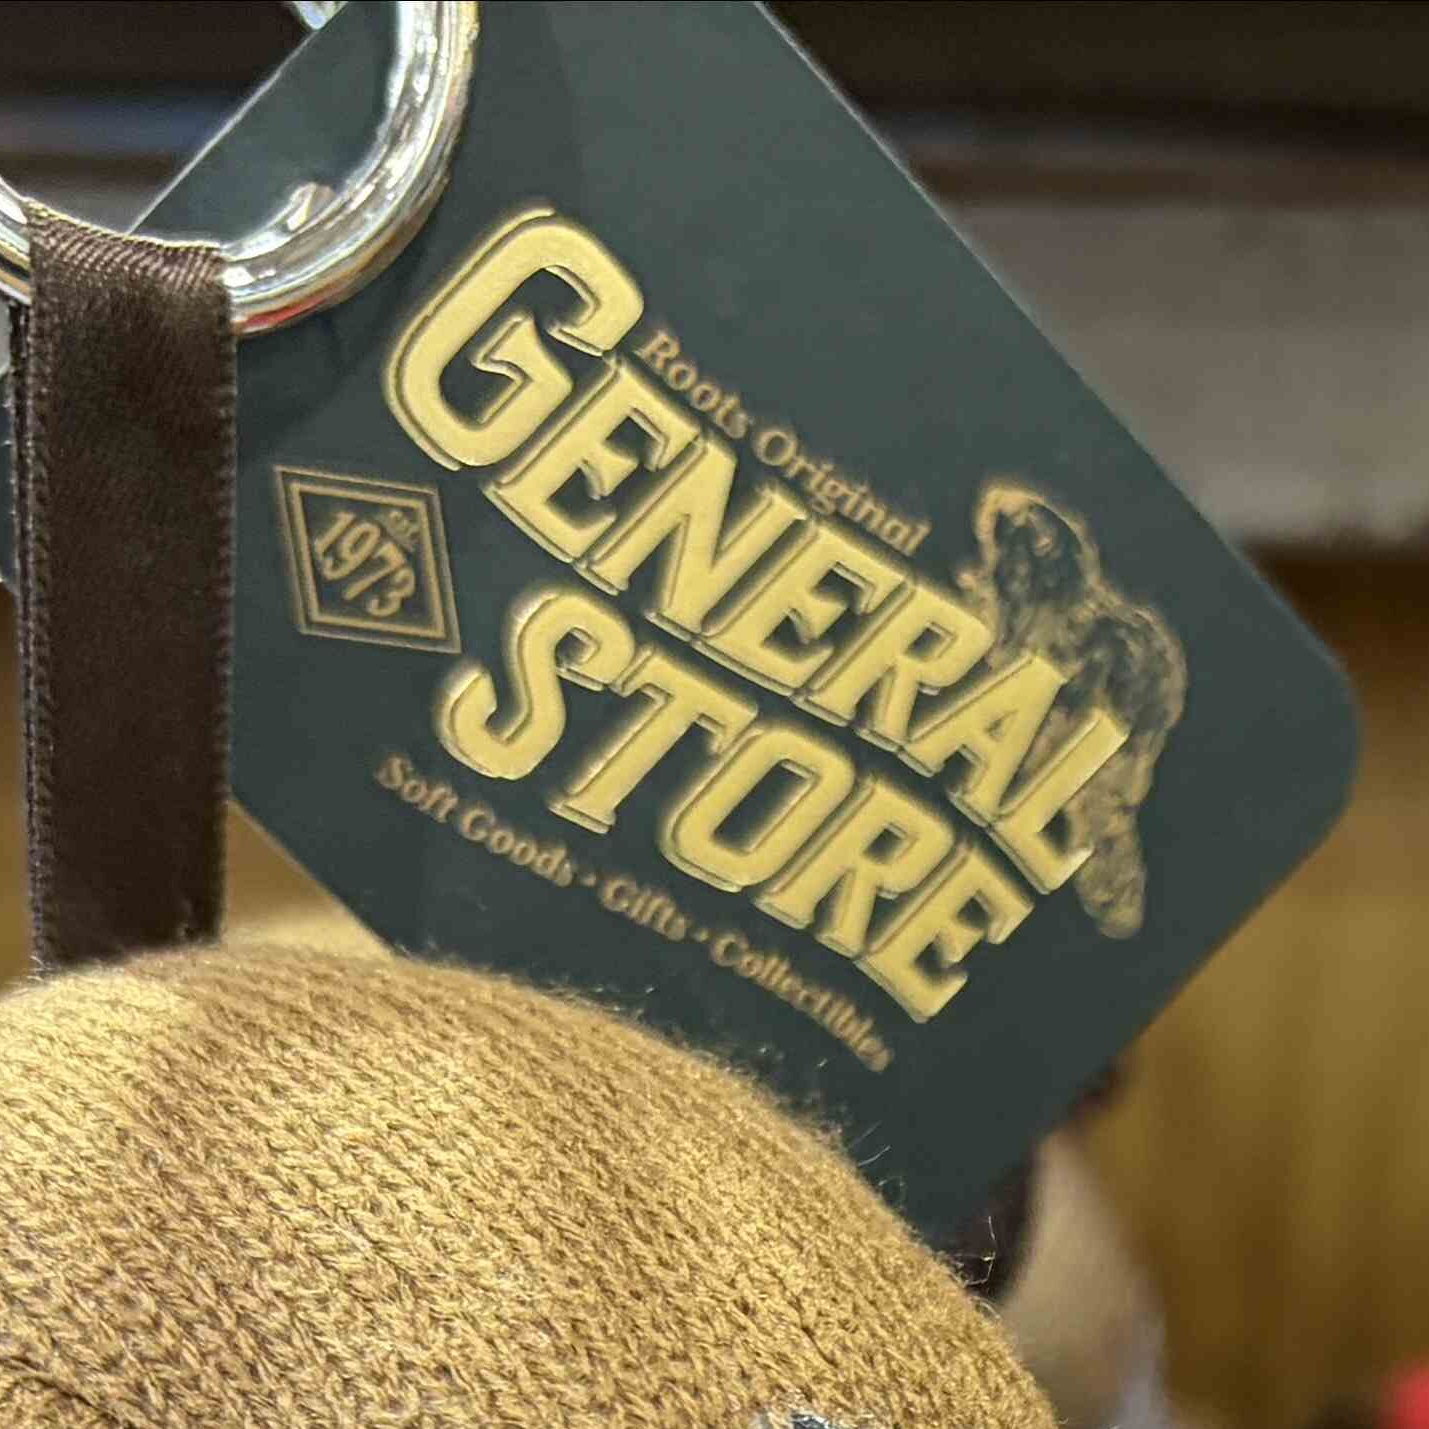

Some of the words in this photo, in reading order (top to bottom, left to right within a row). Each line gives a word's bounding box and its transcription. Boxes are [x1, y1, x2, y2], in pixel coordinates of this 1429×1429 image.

[384, 208, 1128, 895] GENERAL
[634, 330, 752, 439] Roots
[754, 427, 931, 558] Original
[313, 510, 416, 618] 1973
[375, 754, 460, 823] Soft
[460, 802, 574, 887] Goods
[597, 873, 689, 942] Gifts
[434, 593, 1034, 1023] STORE
